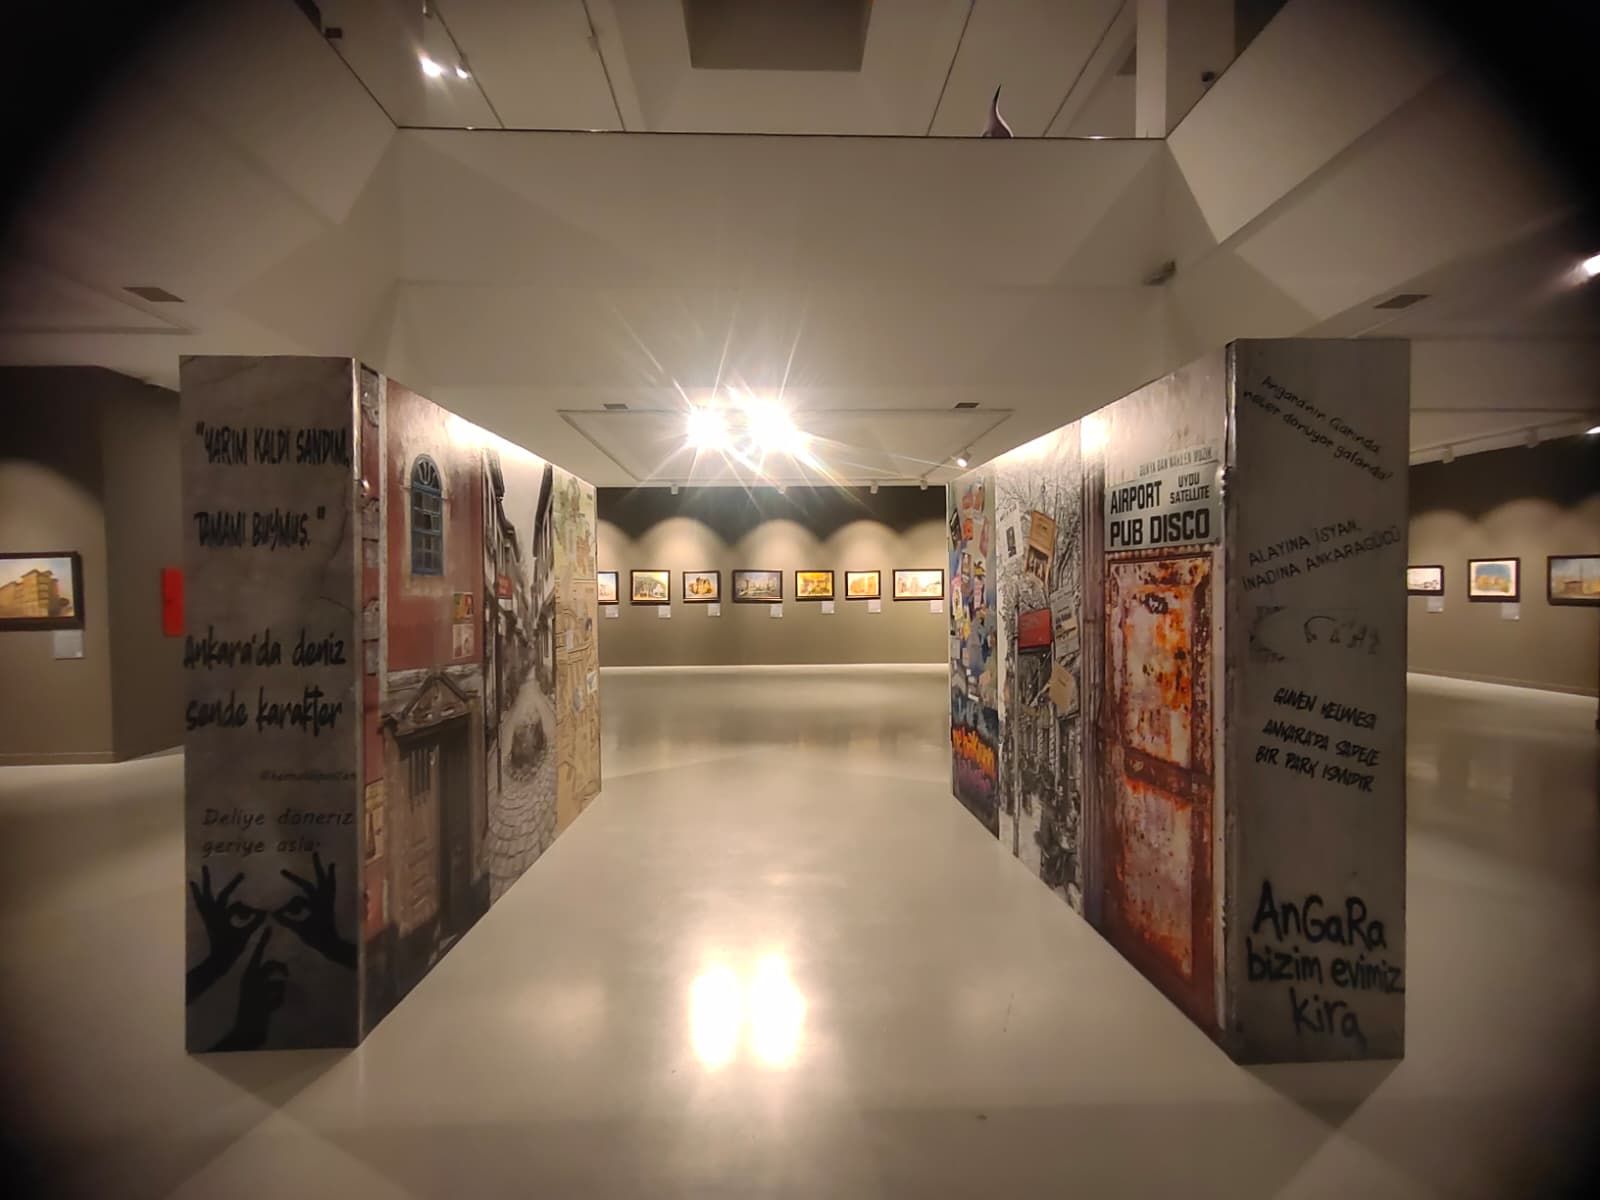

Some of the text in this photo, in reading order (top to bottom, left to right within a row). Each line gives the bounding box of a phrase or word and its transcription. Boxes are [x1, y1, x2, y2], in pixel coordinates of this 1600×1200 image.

[254, 427, 291, 464] KALDI
[1110, 480, 1162, 515] AIRPORT
[1170, 485, 1210, 504] SATELLITE
[1110, 508, 1210, 547] PUB DISCO
[1249, 535, 1311, 566] ALAYINA
[292, 626, 346, 667] deniz
[256, 685, 343, 736] karakter
[1285, 752, 1319, 778] PARK
[202, 808, 266, 831] Deliye
[202, 837, 266, 859] geriye
[1252, 879, 1387, 952] AnGaRa
[1247, 936, 1405, 994] bizim evimiz
